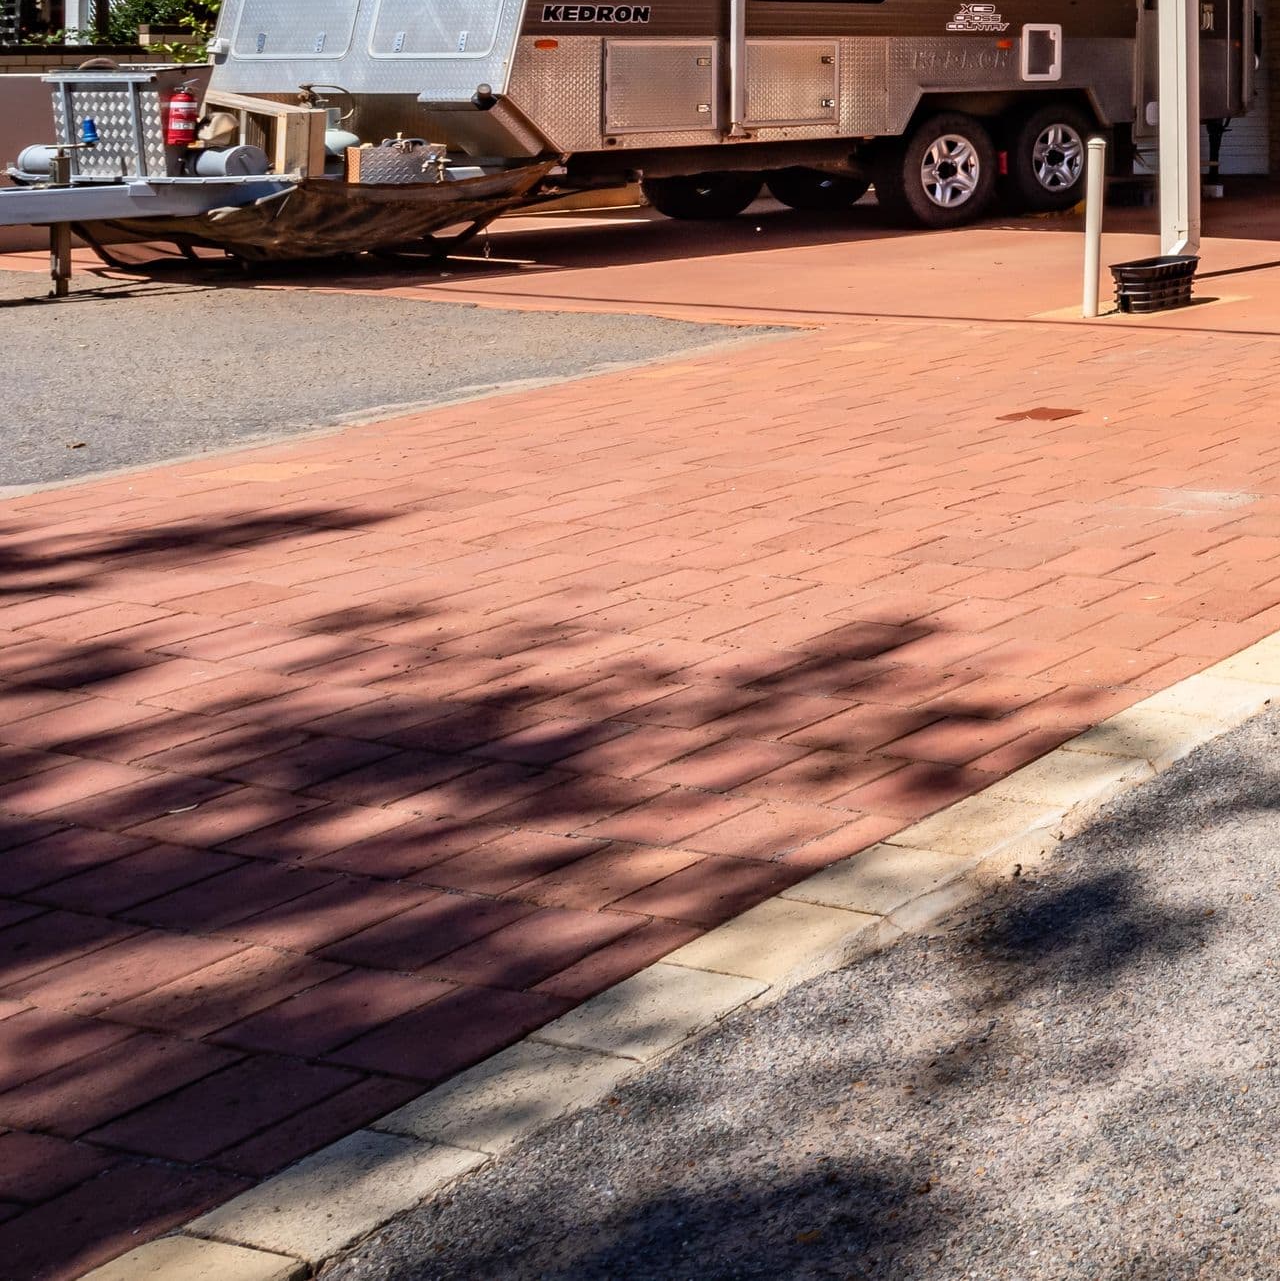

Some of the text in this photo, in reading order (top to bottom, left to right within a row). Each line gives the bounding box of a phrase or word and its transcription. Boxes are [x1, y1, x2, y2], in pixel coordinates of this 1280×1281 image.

[542, 4, 651, 23] KEDRON
[954, 14, 1001, 22] CROSS
[946, 22, 1010, 31] COUNTRY
